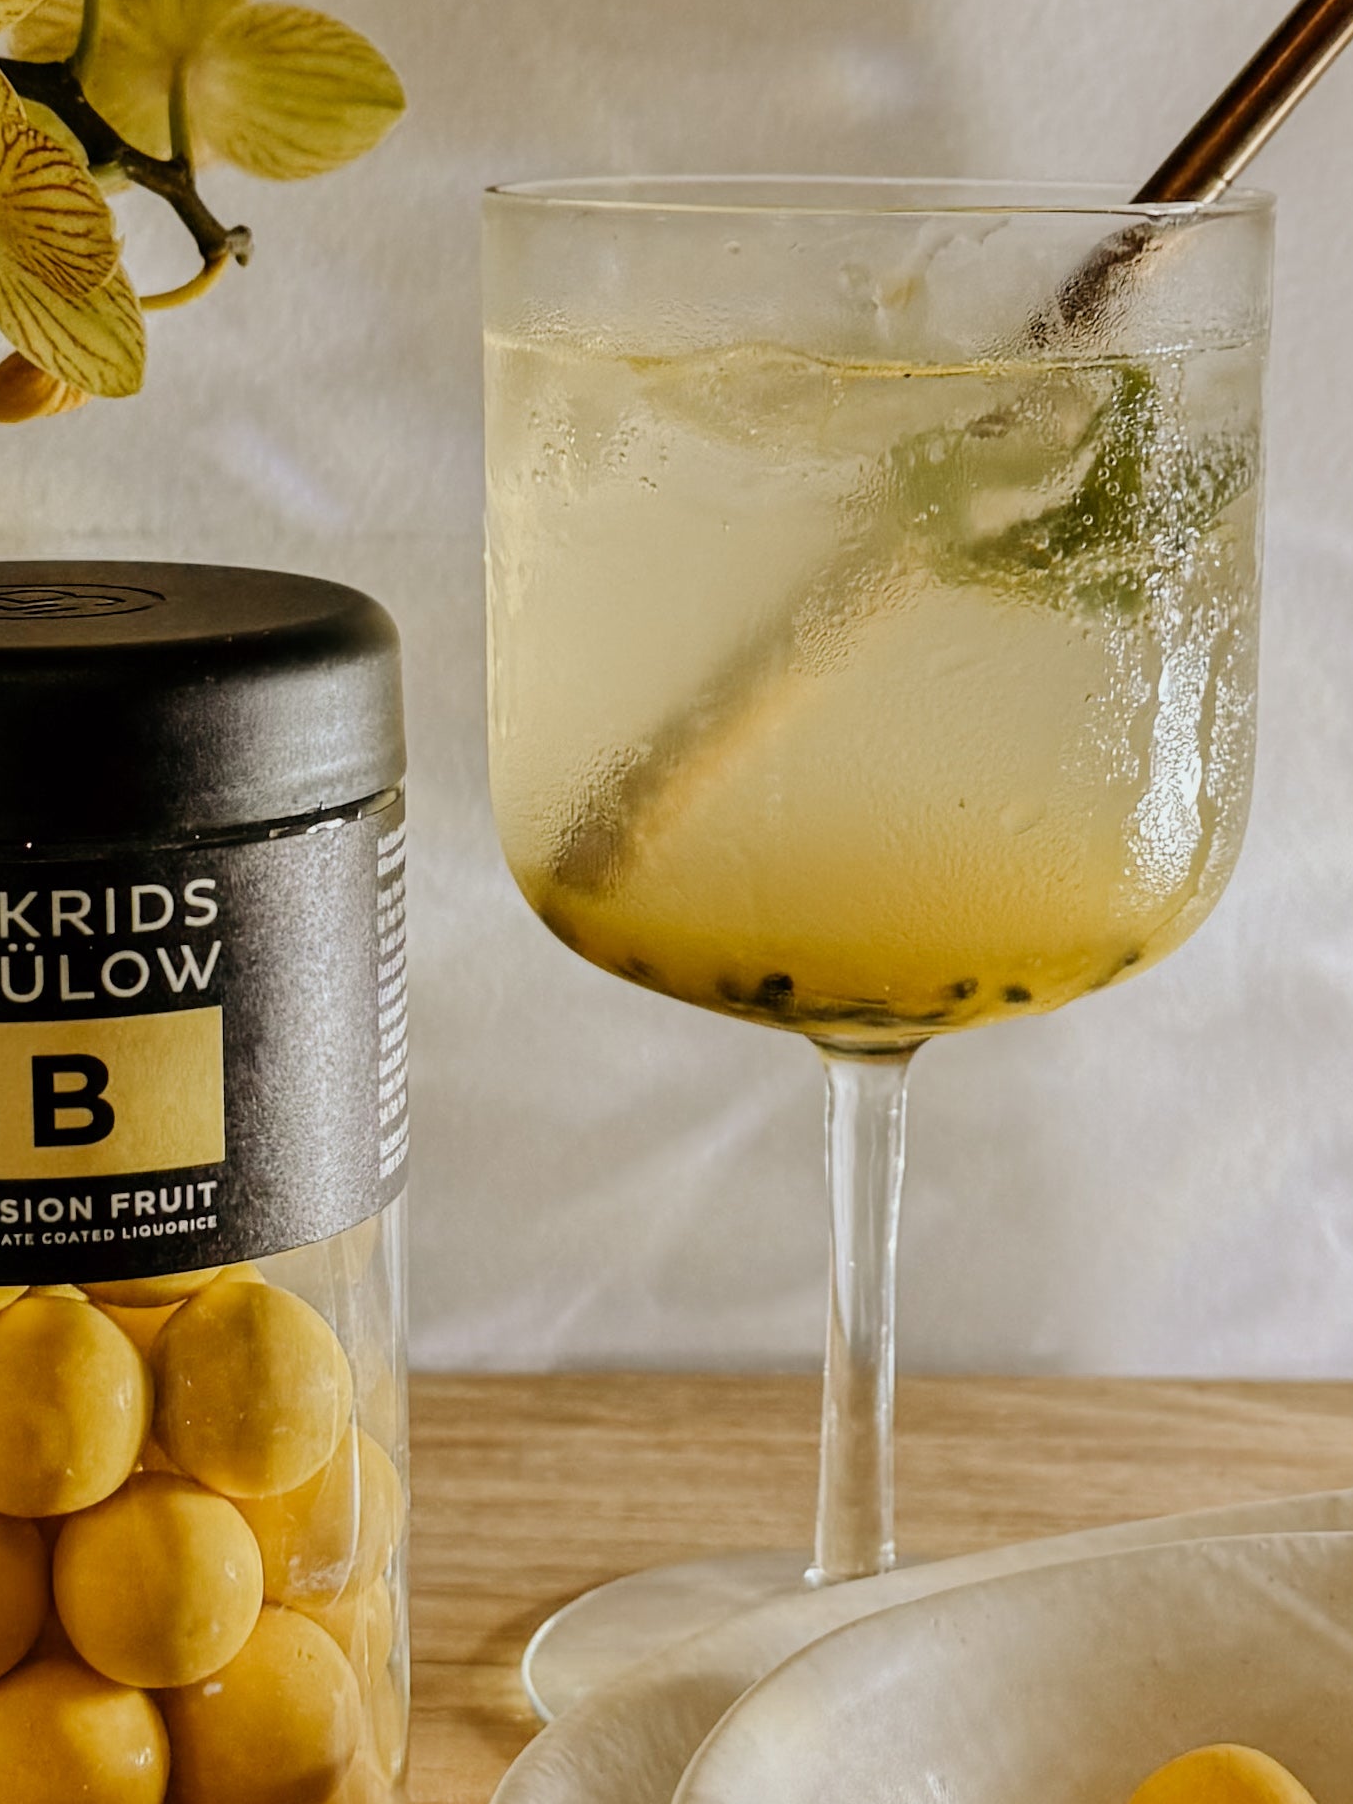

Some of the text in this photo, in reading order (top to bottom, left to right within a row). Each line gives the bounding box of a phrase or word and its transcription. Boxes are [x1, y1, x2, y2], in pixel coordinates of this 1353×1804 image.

[31, 1053, 116, 1149] B
[110, 1180, 218, 1219] FRUIT
[41, 1228, 115, 1245] COATED
[121, 1214, 218, 1240] LIQUORICE
